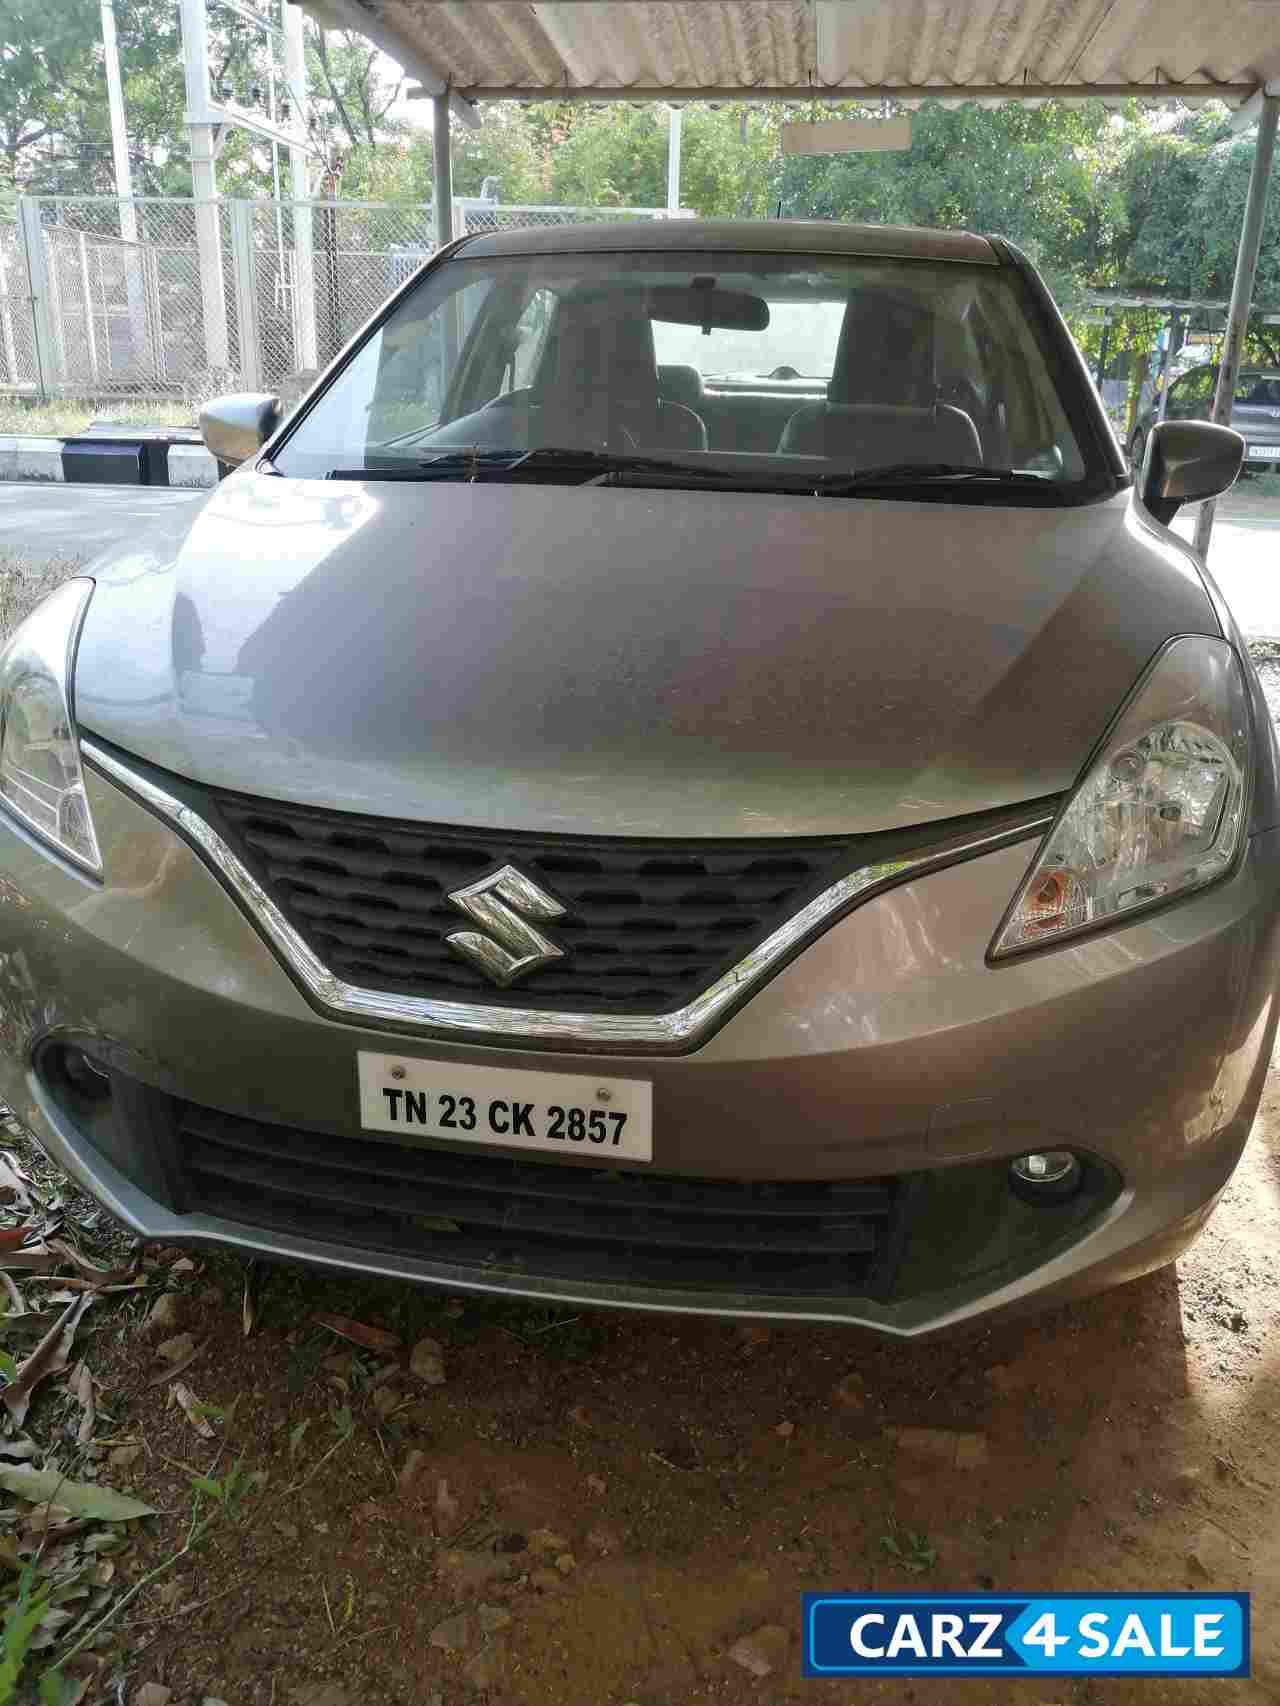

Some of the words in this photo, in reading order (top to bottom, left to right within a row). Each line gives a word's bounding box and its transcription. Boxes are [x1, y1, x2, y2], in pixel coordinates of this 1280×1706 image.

[382, 1087, 427, 1124] TN
[438, 1094, 477, 1130] 23
[488, 1100, 537, 1136] CK
[547, 1105, 628, 1145] 2857
